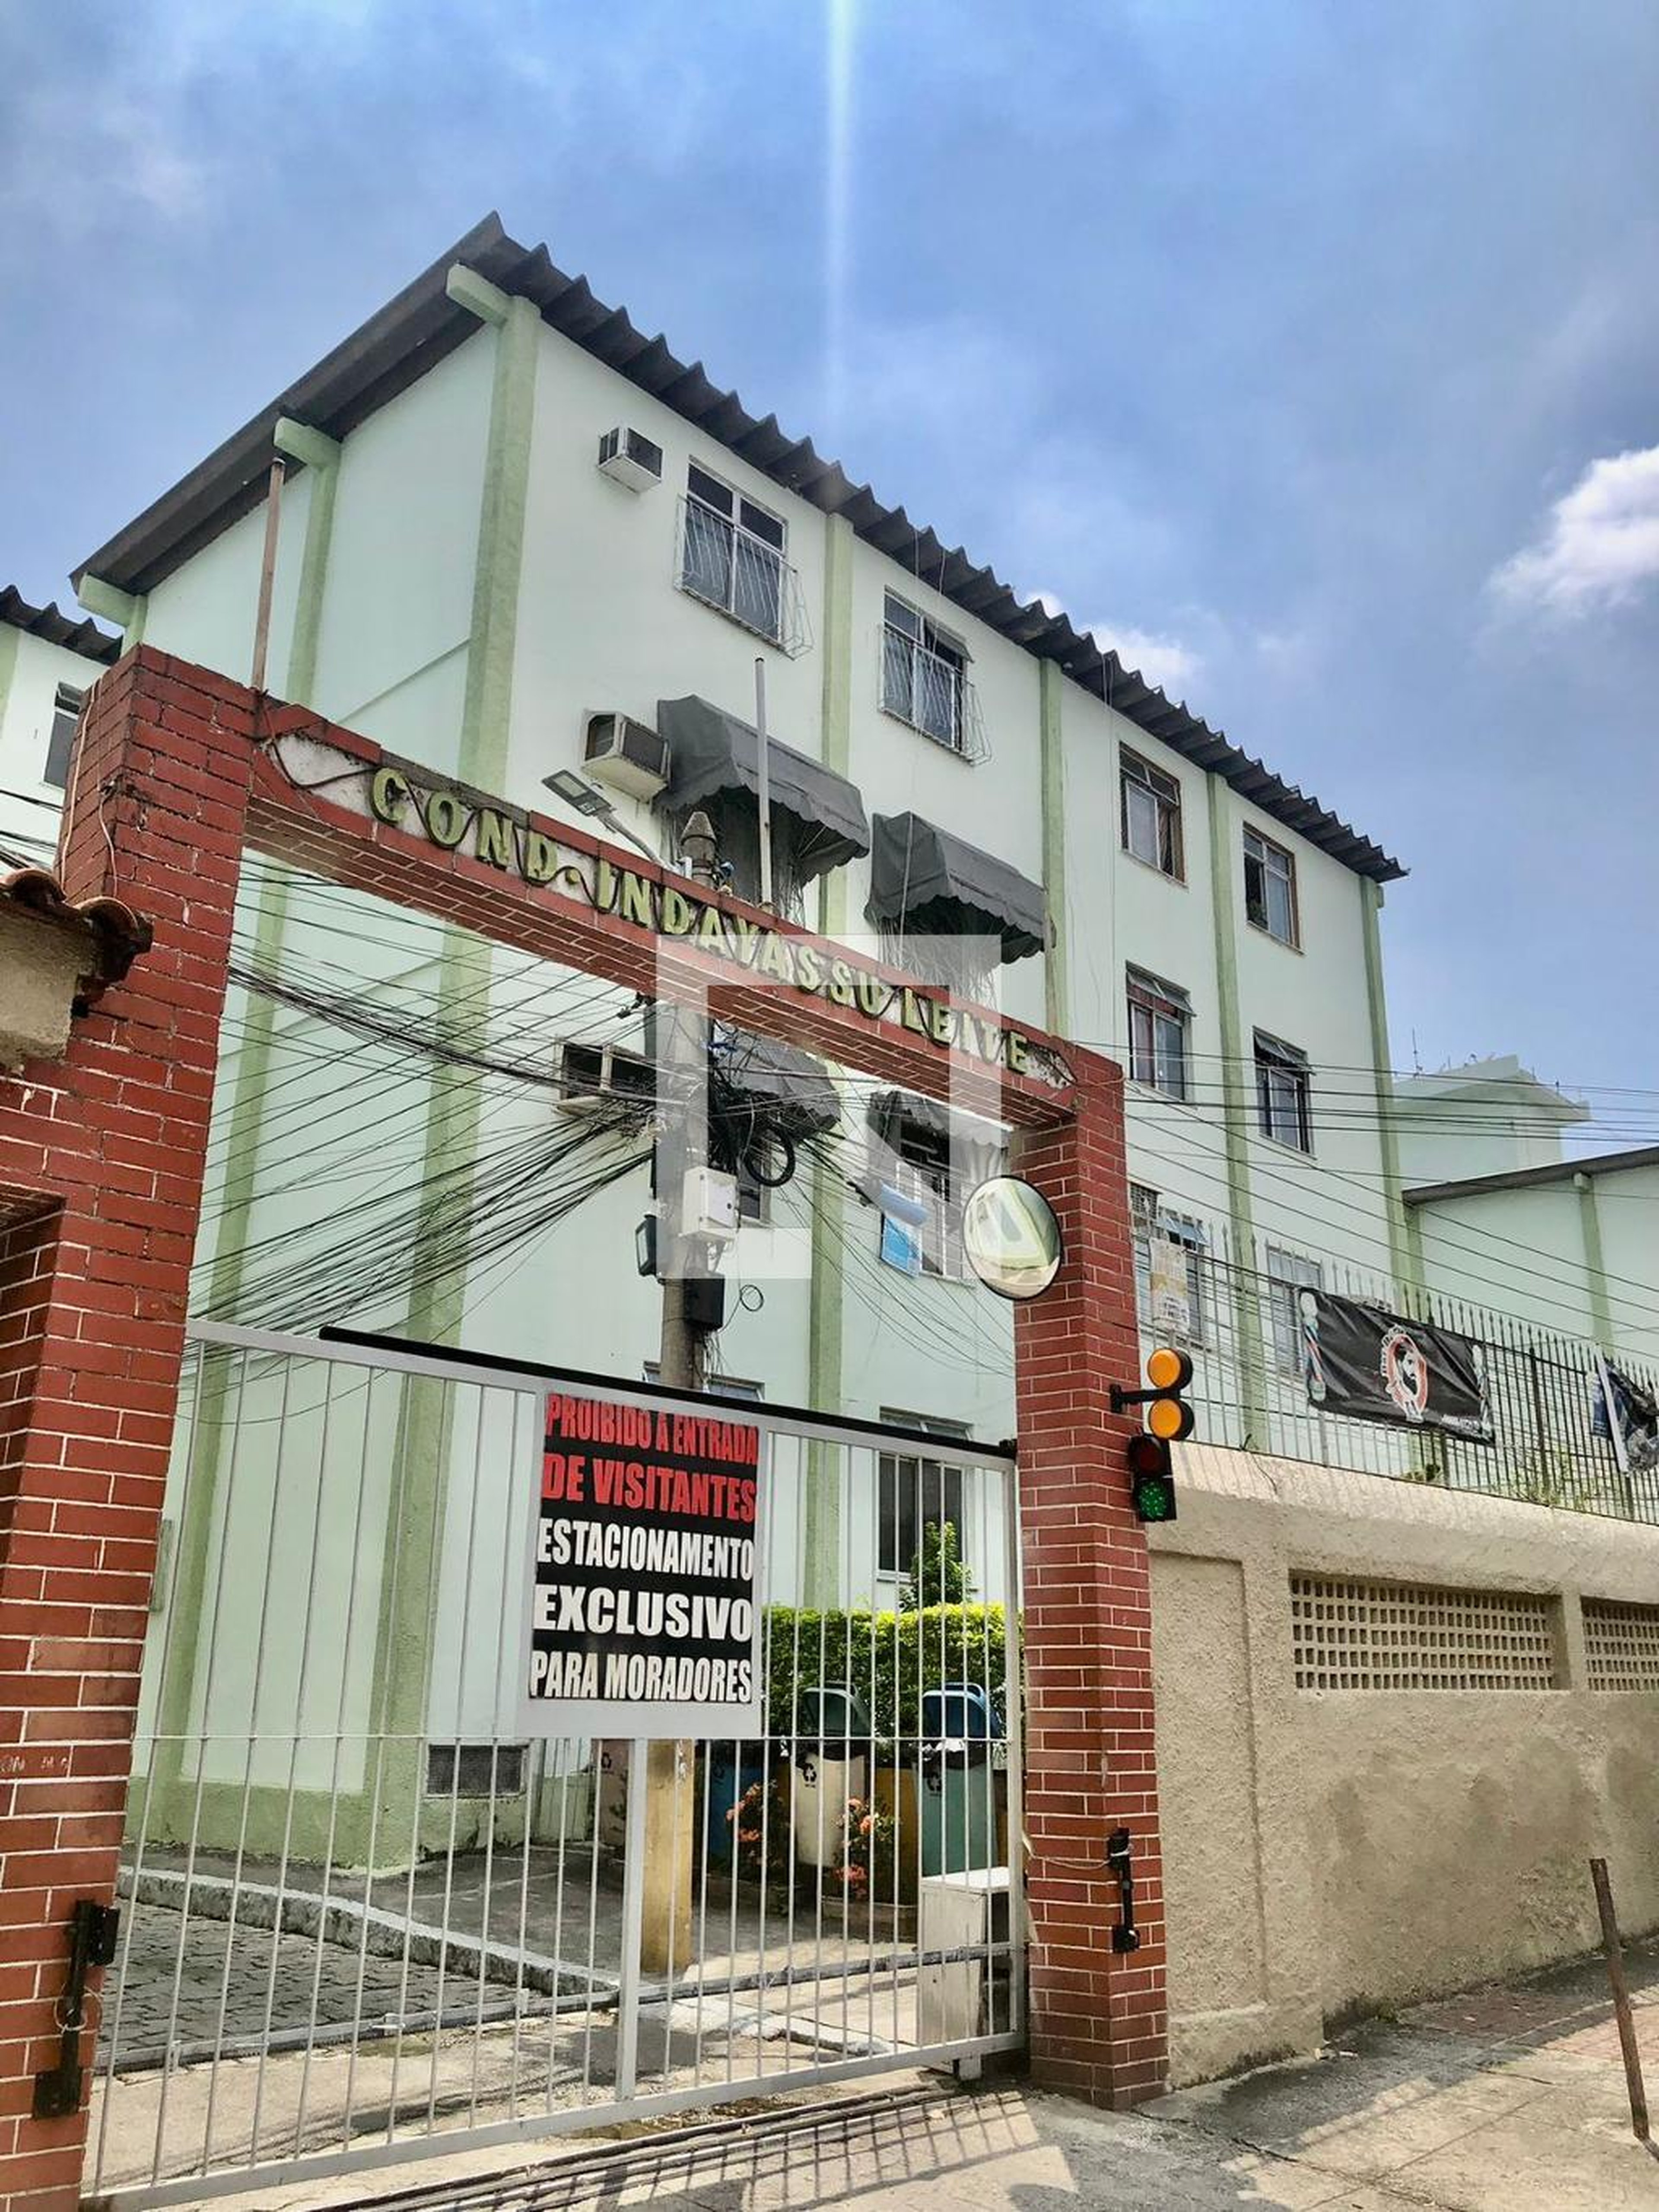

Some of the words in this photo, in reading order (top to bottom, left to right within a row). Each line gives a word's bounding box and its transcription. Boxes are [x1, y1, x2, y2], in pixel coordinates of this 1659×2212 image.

[371, 767, 580, 885] COND.
[546, 1394, 651, 1449] PROIBIDO
[656, 1411, 669, 1452] A
[673, 1415, 759, 1466] ENTRADA
[543, 1453, 586, 1502] DE
[593, 1458, 755, 1523] VISITANTES
[537, 1518, 754, 1581] ESTACIONAMENTO
[532, 1584, 753, 1642] EXCLUSIVO
[530, 1650, 597, 1698] PARA
[604, 1654, 751, 1703] MORADORES
